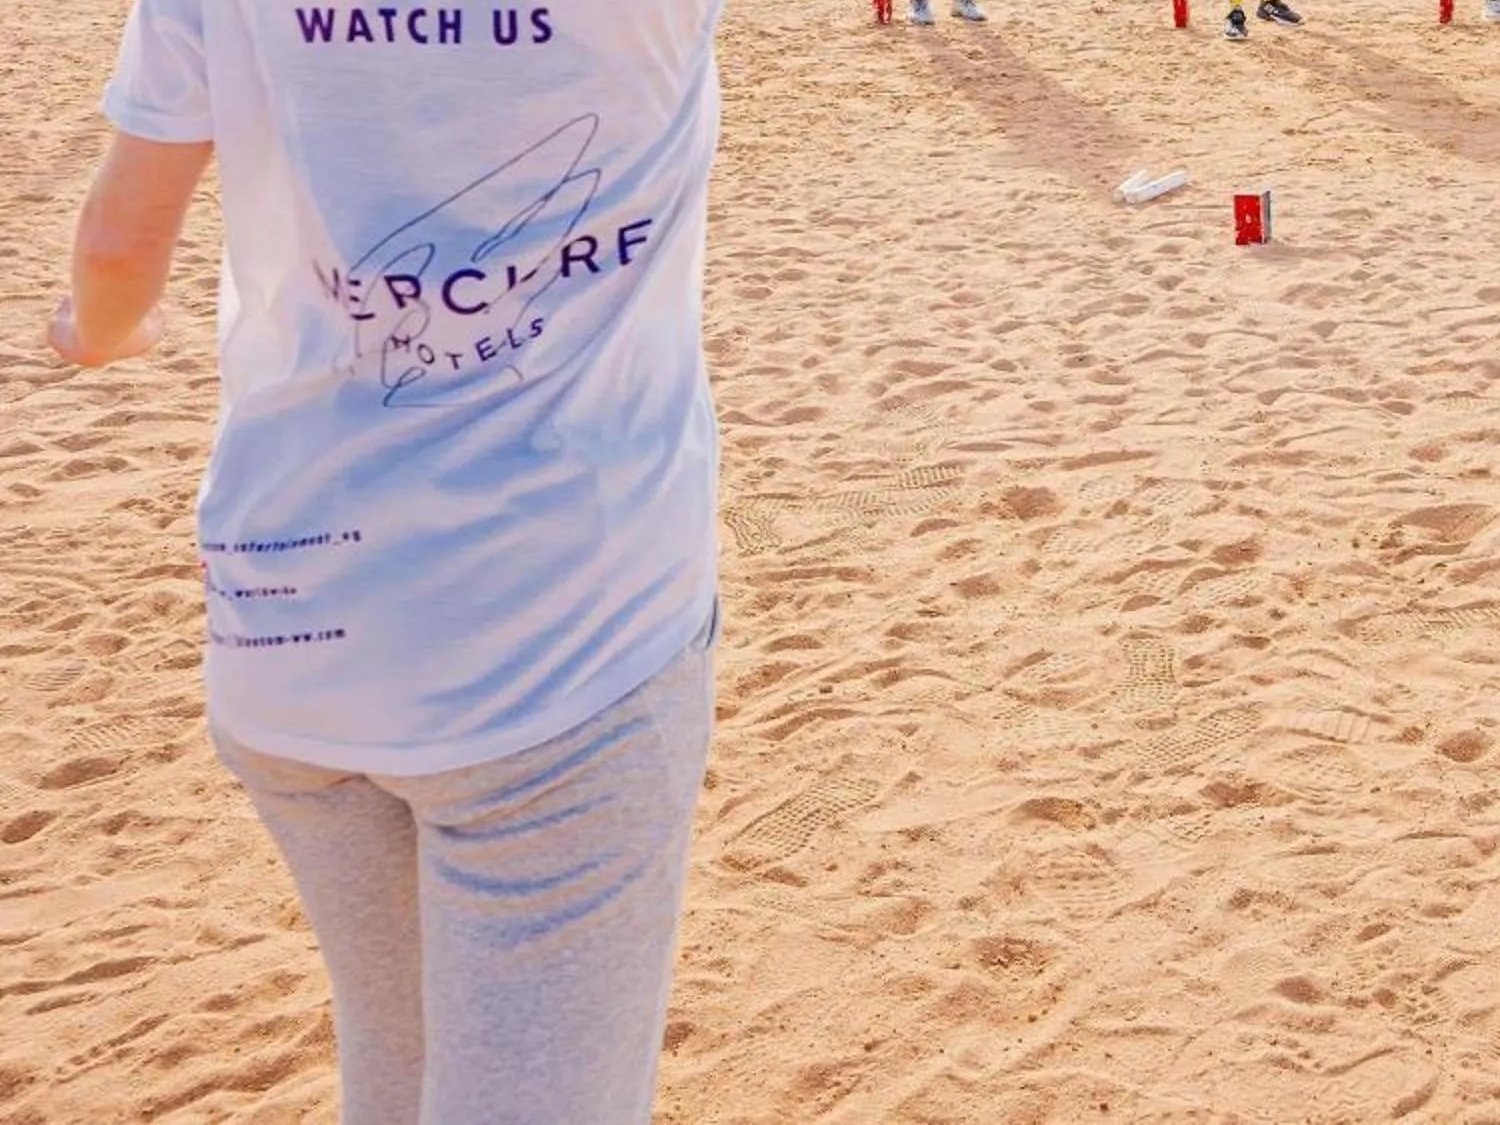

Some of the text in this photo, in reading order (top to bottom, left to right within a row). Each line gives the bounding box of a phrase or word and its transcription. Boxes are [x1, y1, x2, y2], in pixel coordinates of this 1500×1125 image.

[295, 8, 553, 46] WATCH US
[389, 317, 544, 370] HOTELS
